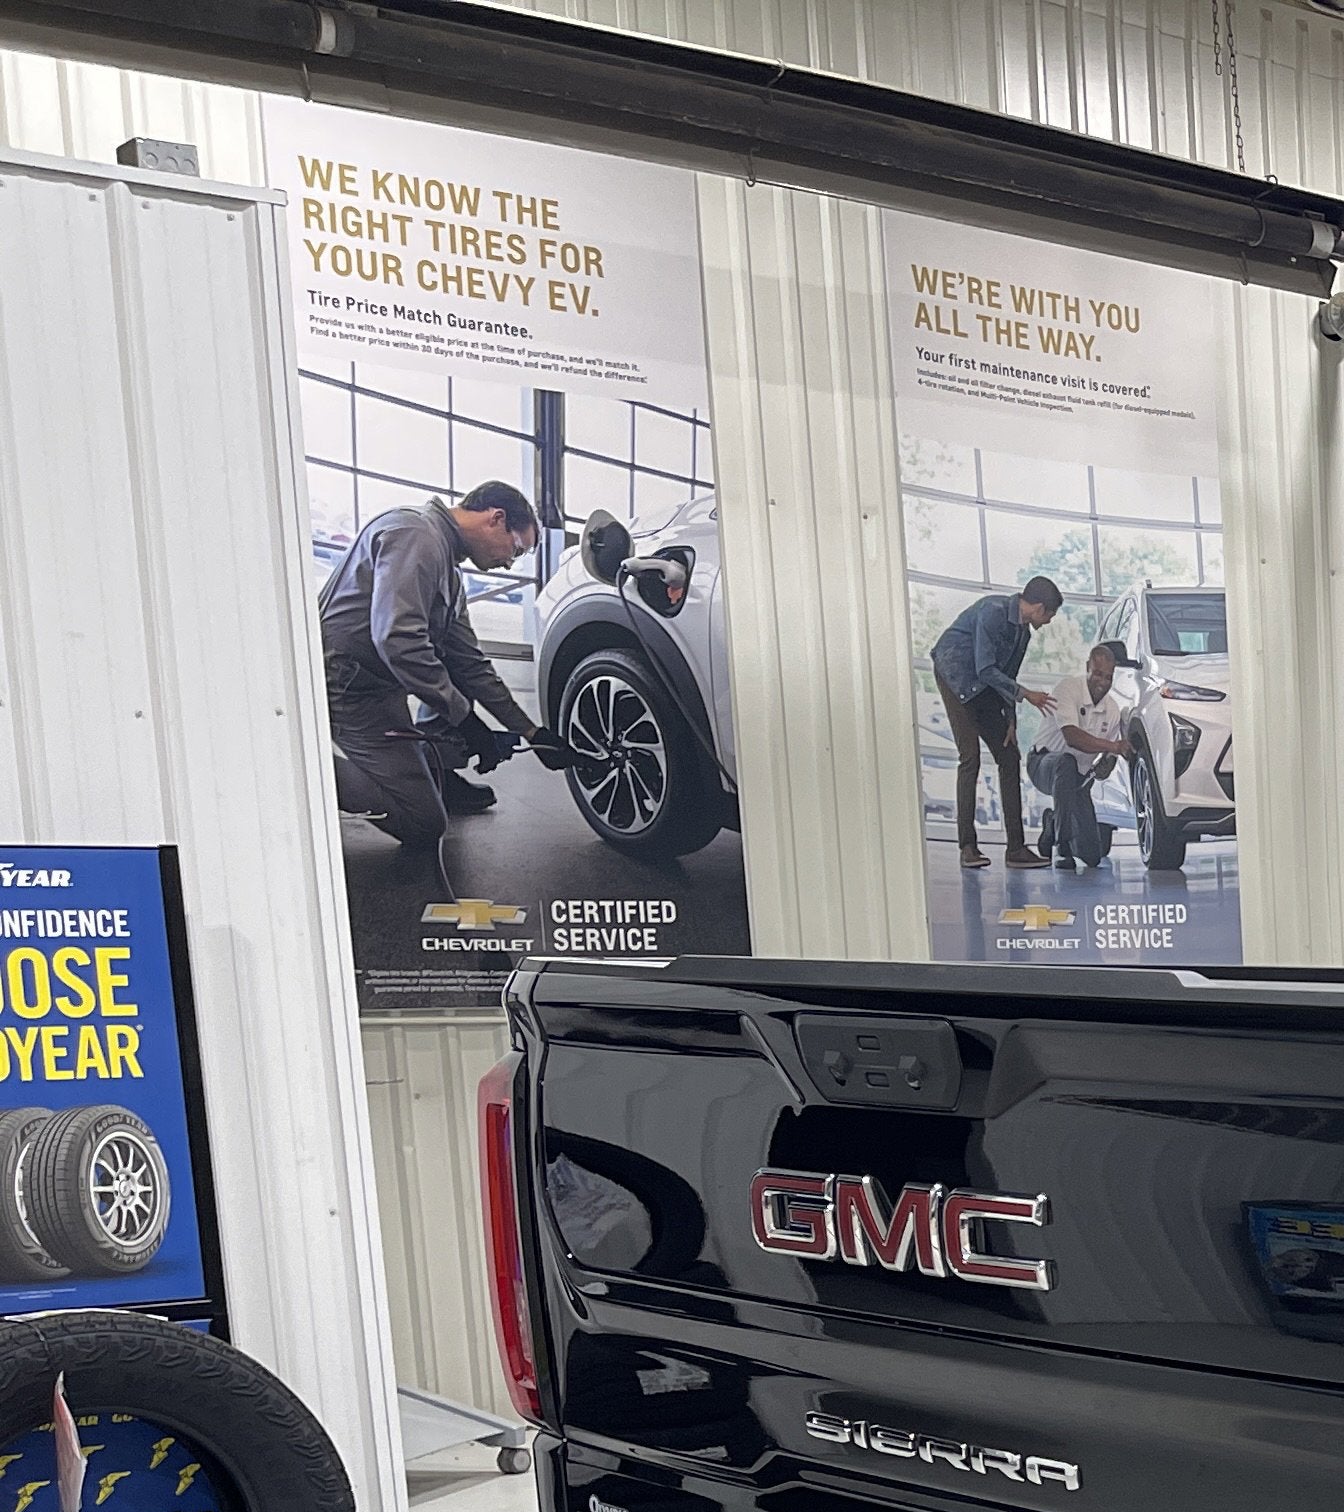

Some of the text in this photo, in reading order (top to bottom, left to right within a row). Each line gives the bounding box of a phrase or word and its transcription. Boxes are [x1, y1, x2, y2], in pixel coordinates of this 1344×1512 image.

[298, 155, 560, 231] WE KNOW THE
[303, 198, 605, 278] RIGHT TIRES FOR
[303, 239, 600, 317] YOUR CHEVY EV.
[911, 263, 1141, 334] WE'RE WITH YOU
[307, 289, 534, 340] Tire Price Match Guarantee.
[913, 302, 1102, 362] ALL THE WAY.
[309, 315, 342, 327] Provide
[345, 321, 355, 330] us
[358, 324, 376, 334] with
[386, 328, 412, 339] better
[415, 333, 445, 345] eligible
[448, 338, 468, 348] price
[481, 343, 494, 351] the
[517, 348, 526, 356] of
[527, 350, 567, 363] purchase,
[569, 355, 583, 364] and
[585, 358, 603, 366] we'll
[605, 360, 629, 370] match
[632, 364, 640, 372] it.
[310, 326, 329, 337] Find
[339, 331, 366, 343] better
[368, 337, 390, 347] price
[392, 341, 419, 351] within
[434, 346, 453, 357] days
[455, 350, 463, 358] of
[466, 352, 479, 360] the
[482, 354, 522, 367] purchase,
[524, 361, 538, 369] and
[541, 363, 559, 372] we'll
[561, 365, 587, 376] refund
[590, 368, 602, 377] the
[914, 346, 945, 364] Your
[948, 352, 977, 371] first
[980, 359, 1058, 386] maintenance
[1062, 372, 1086, 391] visit
[1089, 378, 1099, 392] is
[0, 909, 130, 938] NFIDENCE
[550, 899, 678, 925] CERTIFIED
[1093, 904, 1188, 925] CERTIFIED
[421, 936, 535, 953] CHEVROLET
[552, 927, 659, 952] SERVICE
[996, 938, 1082, 950] CHEVROLET
[1095, 928, 1174, 949] SERVICE
[0, 946, 139, 1019] OSE
[750, 1167, 1054, 1291] GMC
[805, 1410, 1083, 1491] SIERRA
